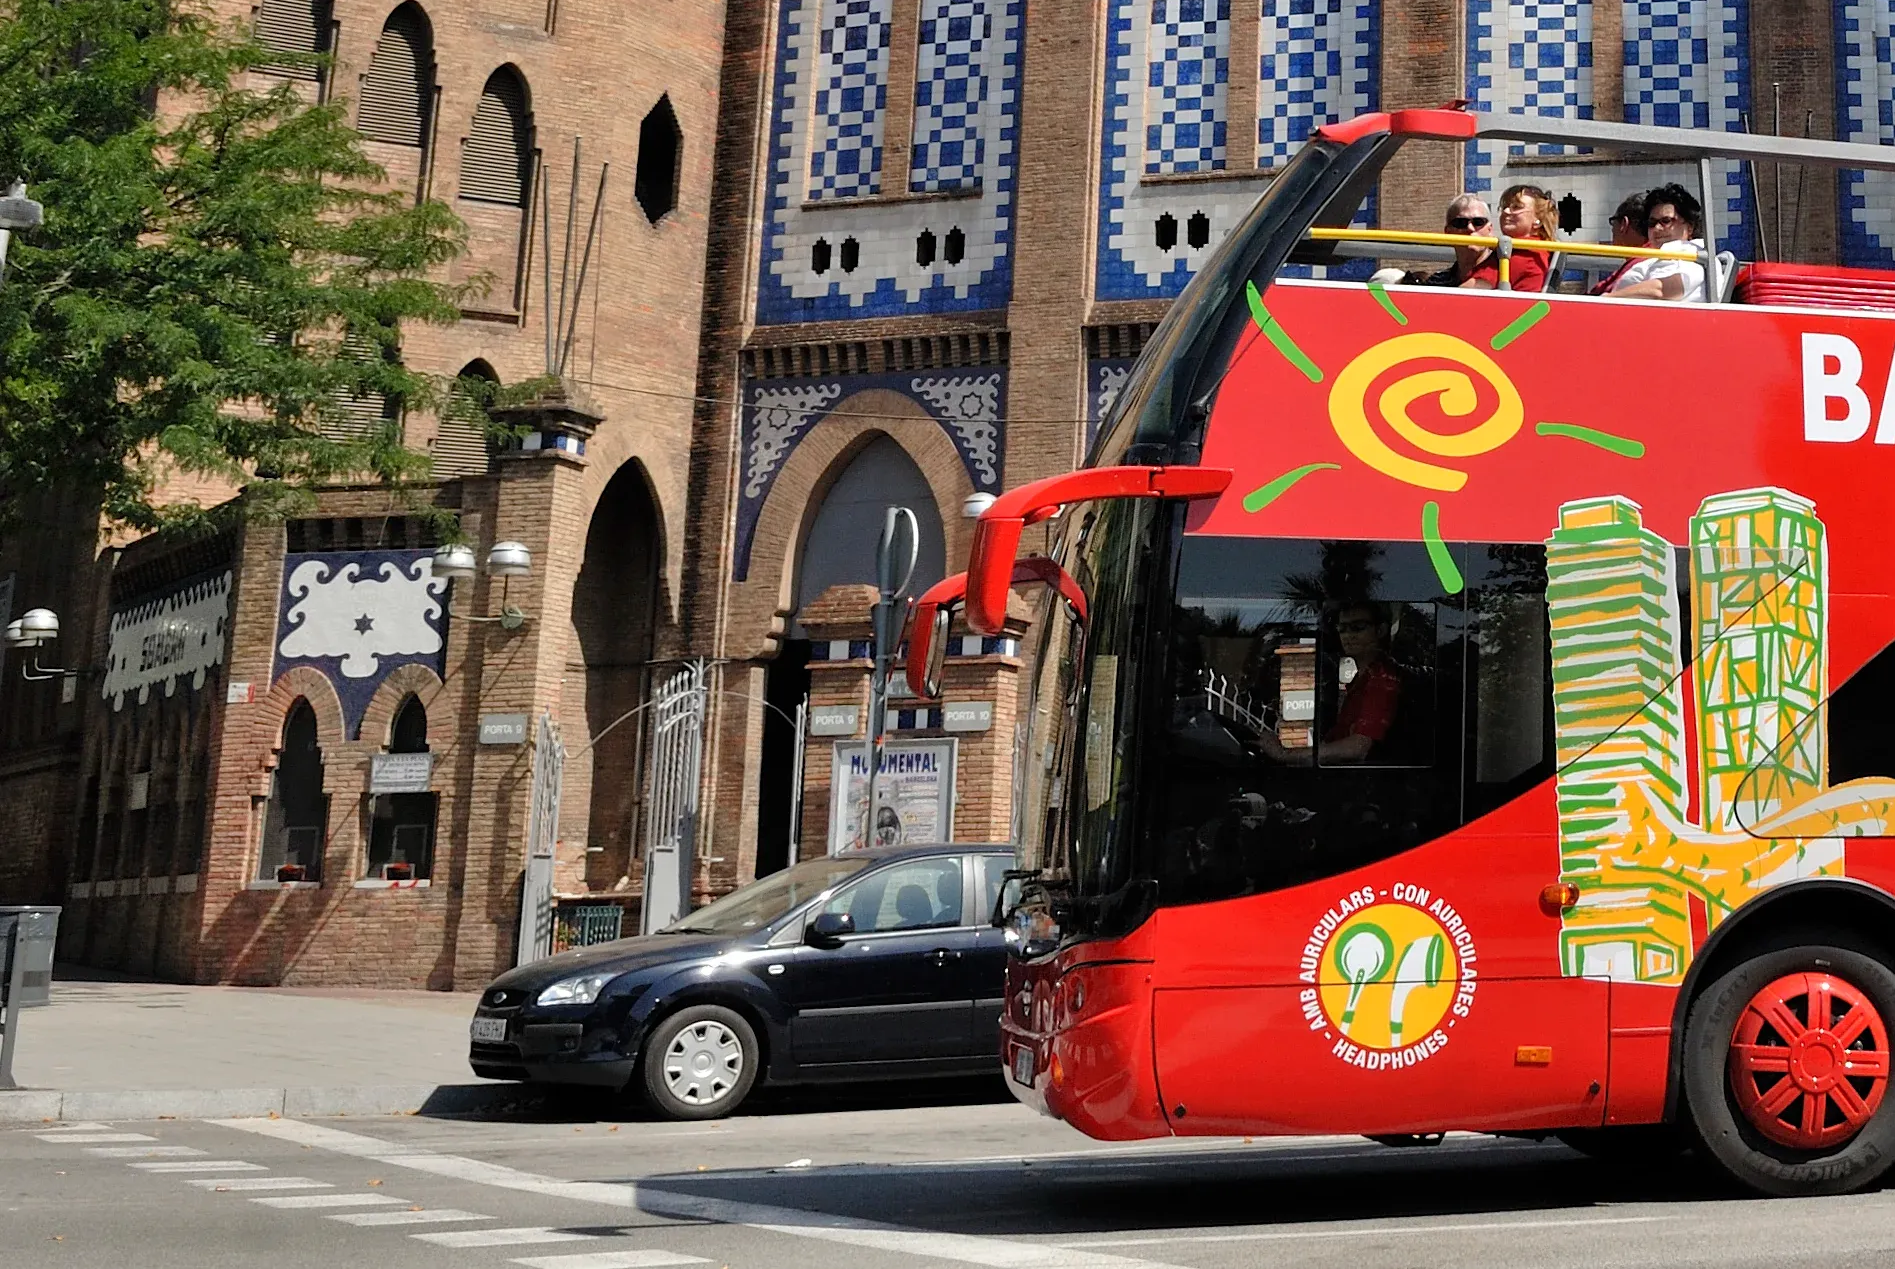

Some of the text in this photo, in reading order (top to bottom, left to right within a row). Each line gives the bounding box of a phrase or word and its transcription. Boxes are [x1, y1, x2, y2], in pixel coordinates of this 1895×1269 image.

[1285, 699, 1315, 711] PORTA
[815, 715, 845, 726] PORTA
[946, 711, 976, 722] PORTA
[851, 753, 938, 775] MOUMENTAL
[1299, 882, 1478, 1032] AMB AURICULARS CON AURICULARES
[1331, 1028, 1449, 1071] HEADPHONES
